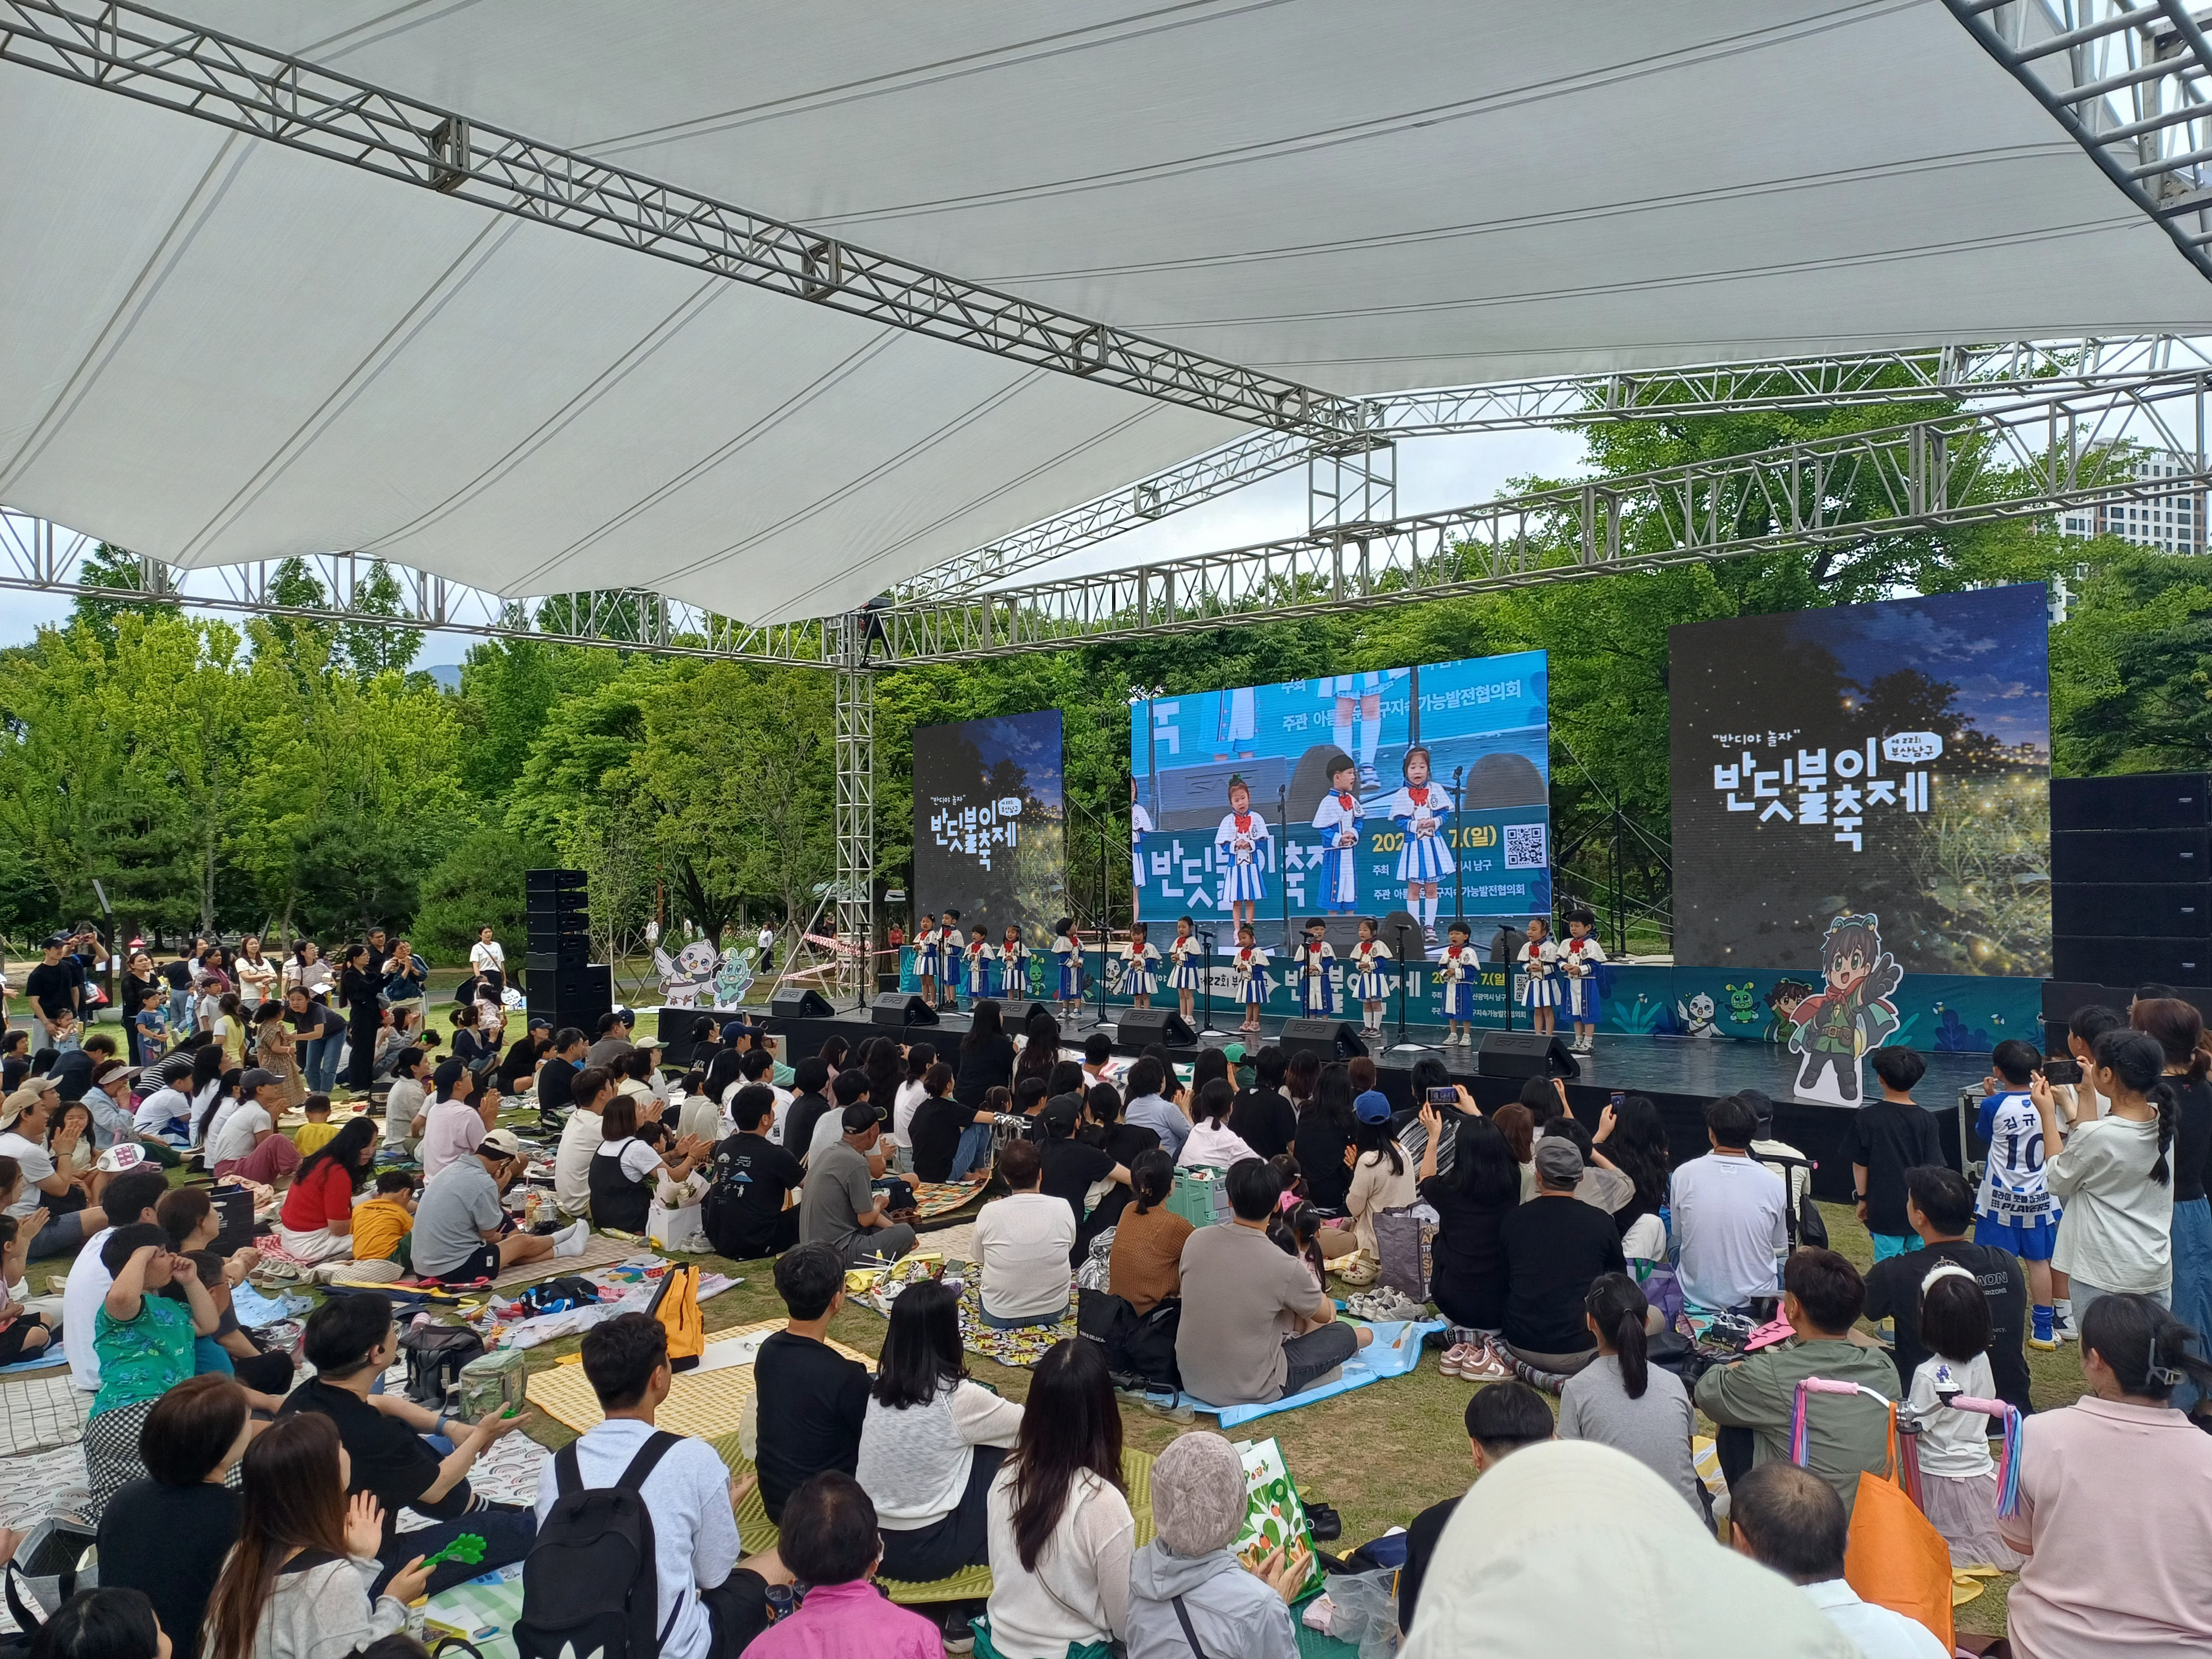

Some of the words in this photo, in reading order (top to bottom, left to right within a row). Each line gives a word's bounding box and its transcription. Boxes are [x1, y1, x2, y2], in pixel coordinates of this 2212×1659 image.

[1283, 713, 1308, 732] 주관
[1891, 745, 1934, 758] 부산남구
[1373, 864, 1389, 876] 주최
[1473, 859, 1492, 872] 남구
[1374, 889, 1391, 900] 주관
[1472, 993, 1494, 1001] 산광역시
[2006, 1133, 2046, 1173] 10
[2001, 1201, 2051, 1213] PLAYERS
